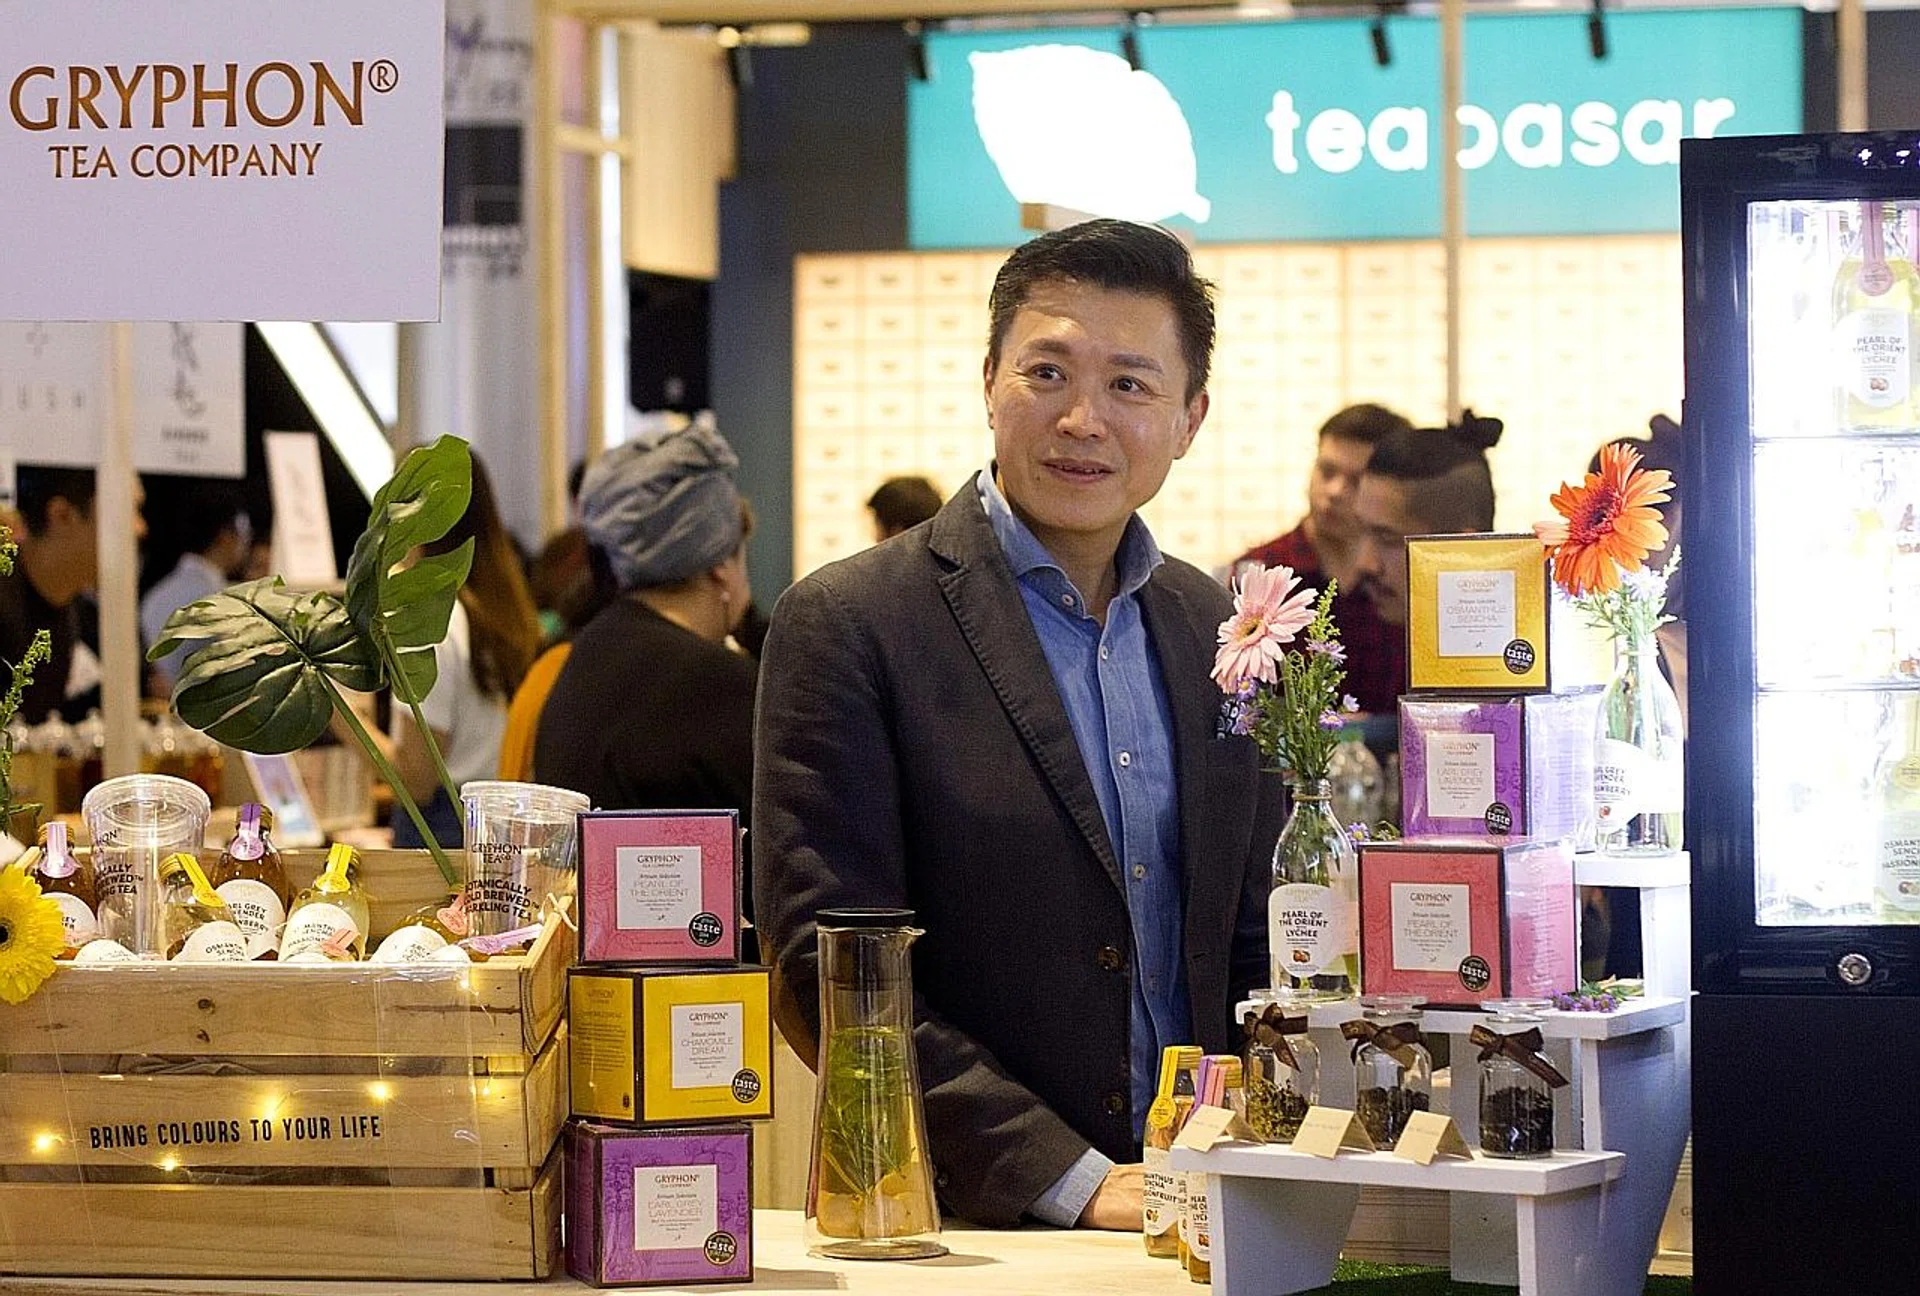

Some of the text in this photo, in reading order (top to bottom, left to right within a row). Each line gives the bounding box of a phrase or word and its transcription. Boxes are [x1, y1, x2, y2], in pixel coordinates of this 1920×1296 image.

[48, 143, 323, 178] TEA COMPANY
[117, 884, 137, 895] TEA
[1282, 910, 1323, 919] PEARL OF
[692, 921, 721, 935] taste
[1279, 918, 1329, 928] THE ORIENT
[1285, 929, 1318, 938] LYCHEE
[1461, 965, 1488, 980] taste
[734, 1078, 759, 1091] taste
[90, 1116, 380, 1148] BRING COLOURS TO YOUR LIFE
[708, 1240, 734, 1253] taste
